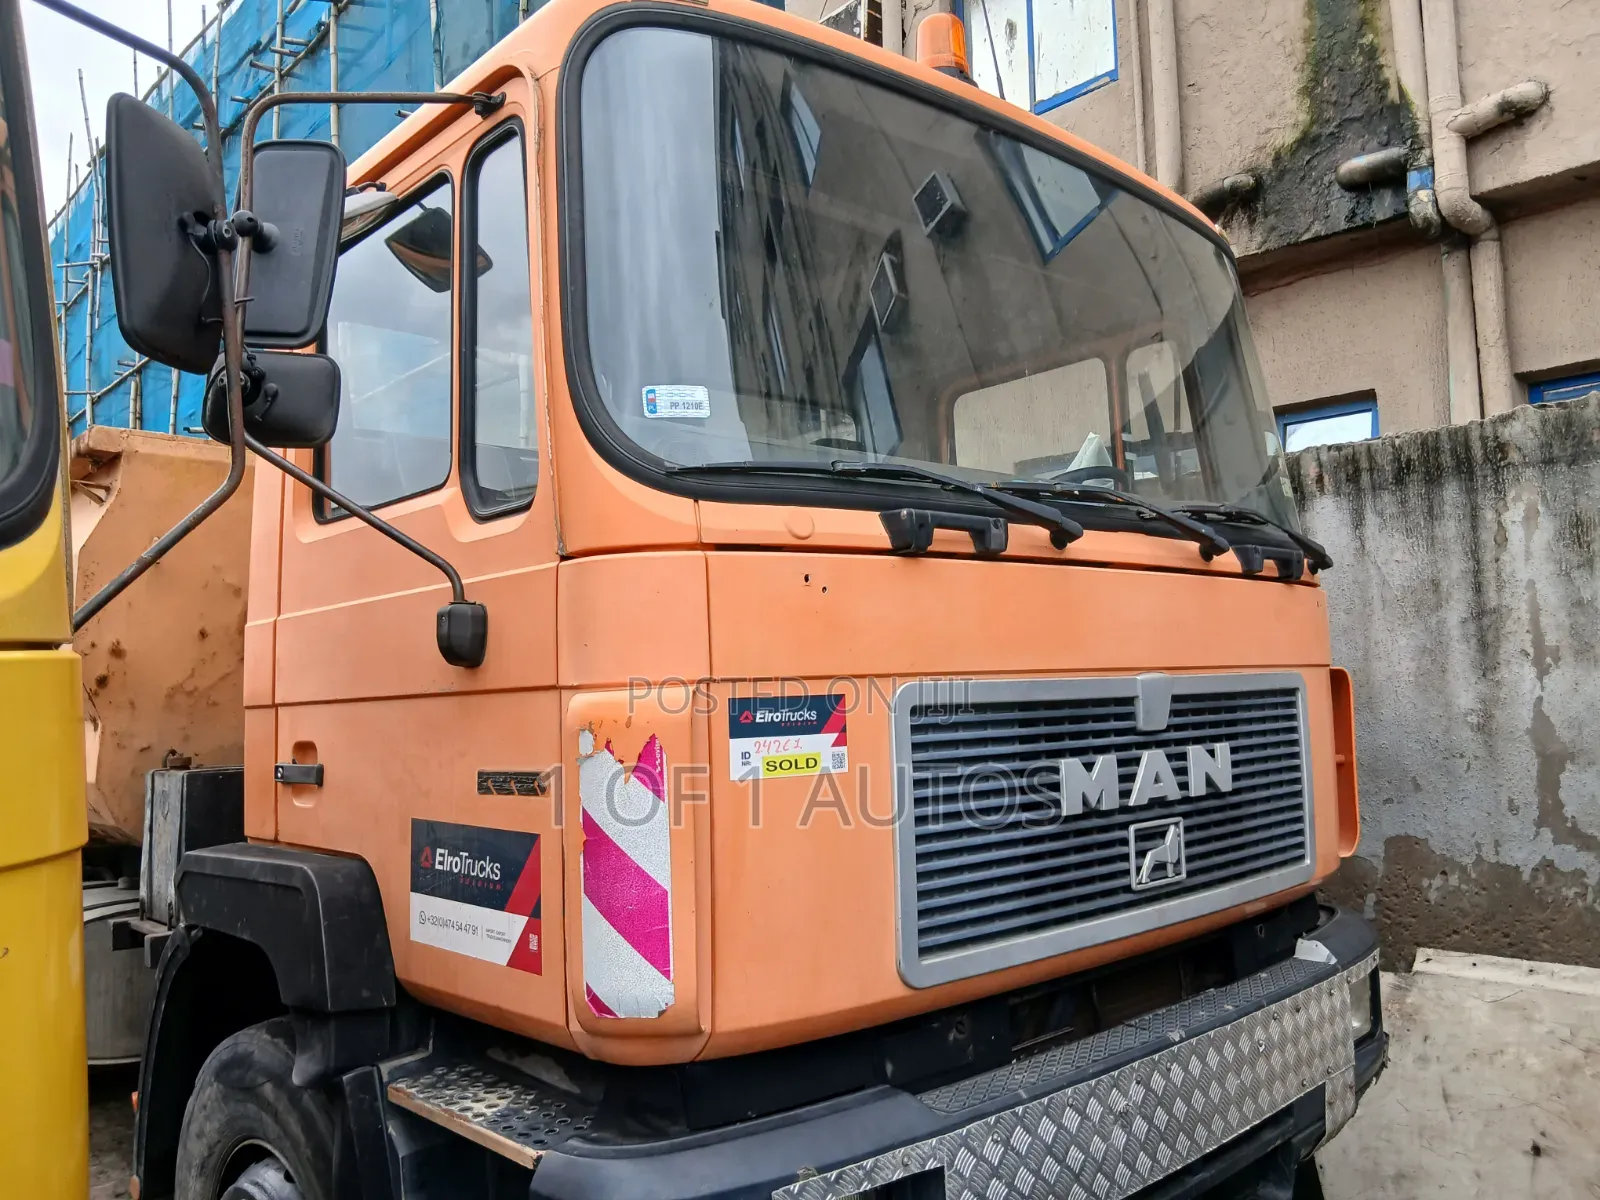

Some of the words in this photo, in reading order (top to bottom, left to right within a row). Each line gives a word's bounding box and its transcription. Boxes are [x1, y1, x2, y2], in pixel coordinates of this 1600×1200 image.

[670, 402, 680, 410] PP
[756, 708, 817, 723] ElroTrucks
[741, 751, 751, 760] ID
[765, 757, 818, 772] SOLD
[1060, 742, 1233, 816] MAN
[435, 847, 501, 881] ElroTrucks
[455, 921, 463, 932] 54
[464, 923, 471, 934] 47
[472, 925, 479, 936] 91
